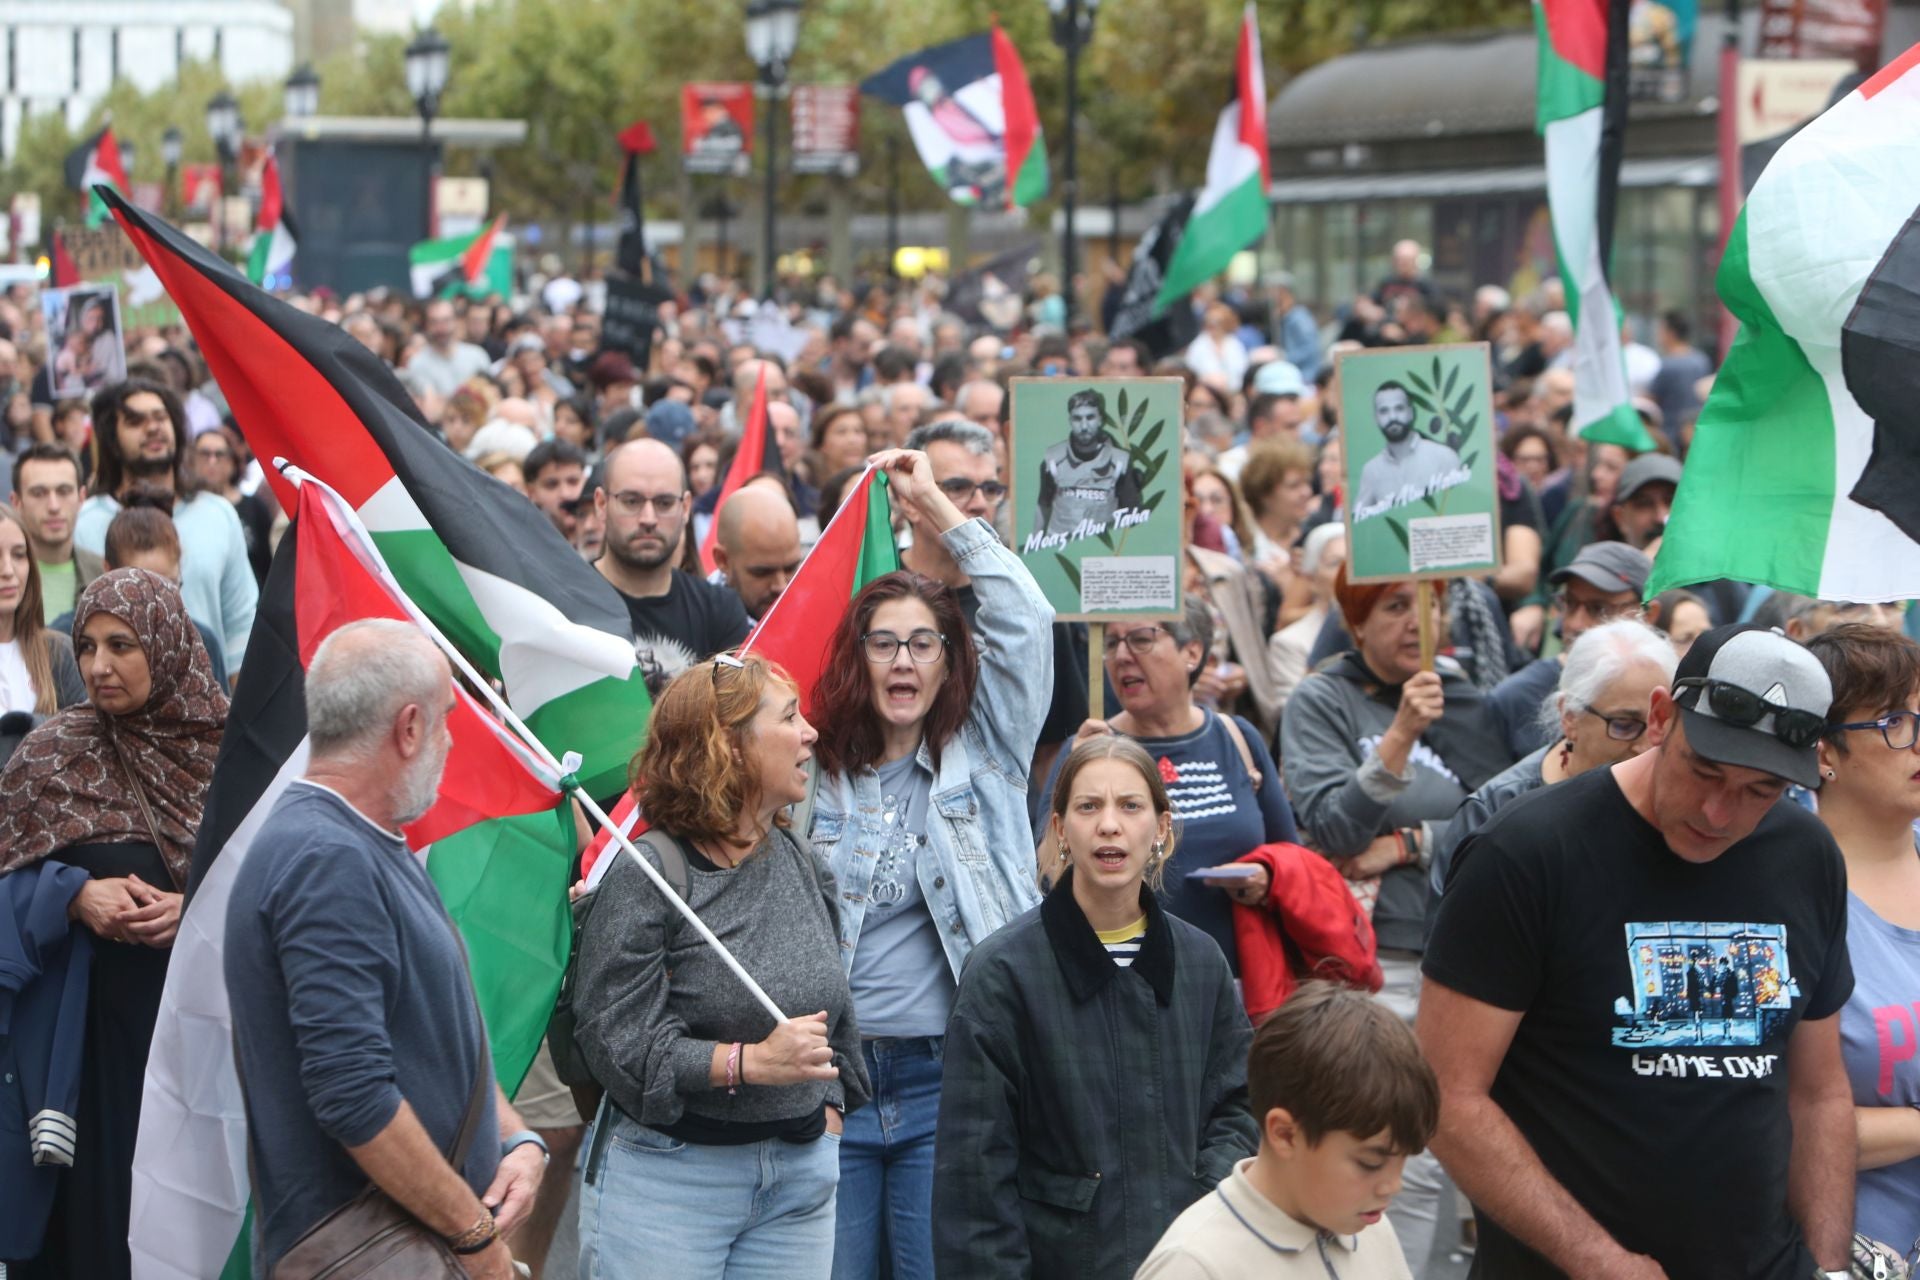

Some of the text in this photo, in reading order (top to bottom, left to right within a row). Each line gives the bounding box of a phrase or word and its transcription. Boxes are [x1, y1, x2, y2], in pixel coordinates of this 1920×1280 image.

[1076, 489, 1106, 500] PRESS
[1024, 507, 1151, 554] Moaz Abu Taha
[1631, 1053, 1723, 1078] GAME
[1872, 1001, 1920, 1096] P
